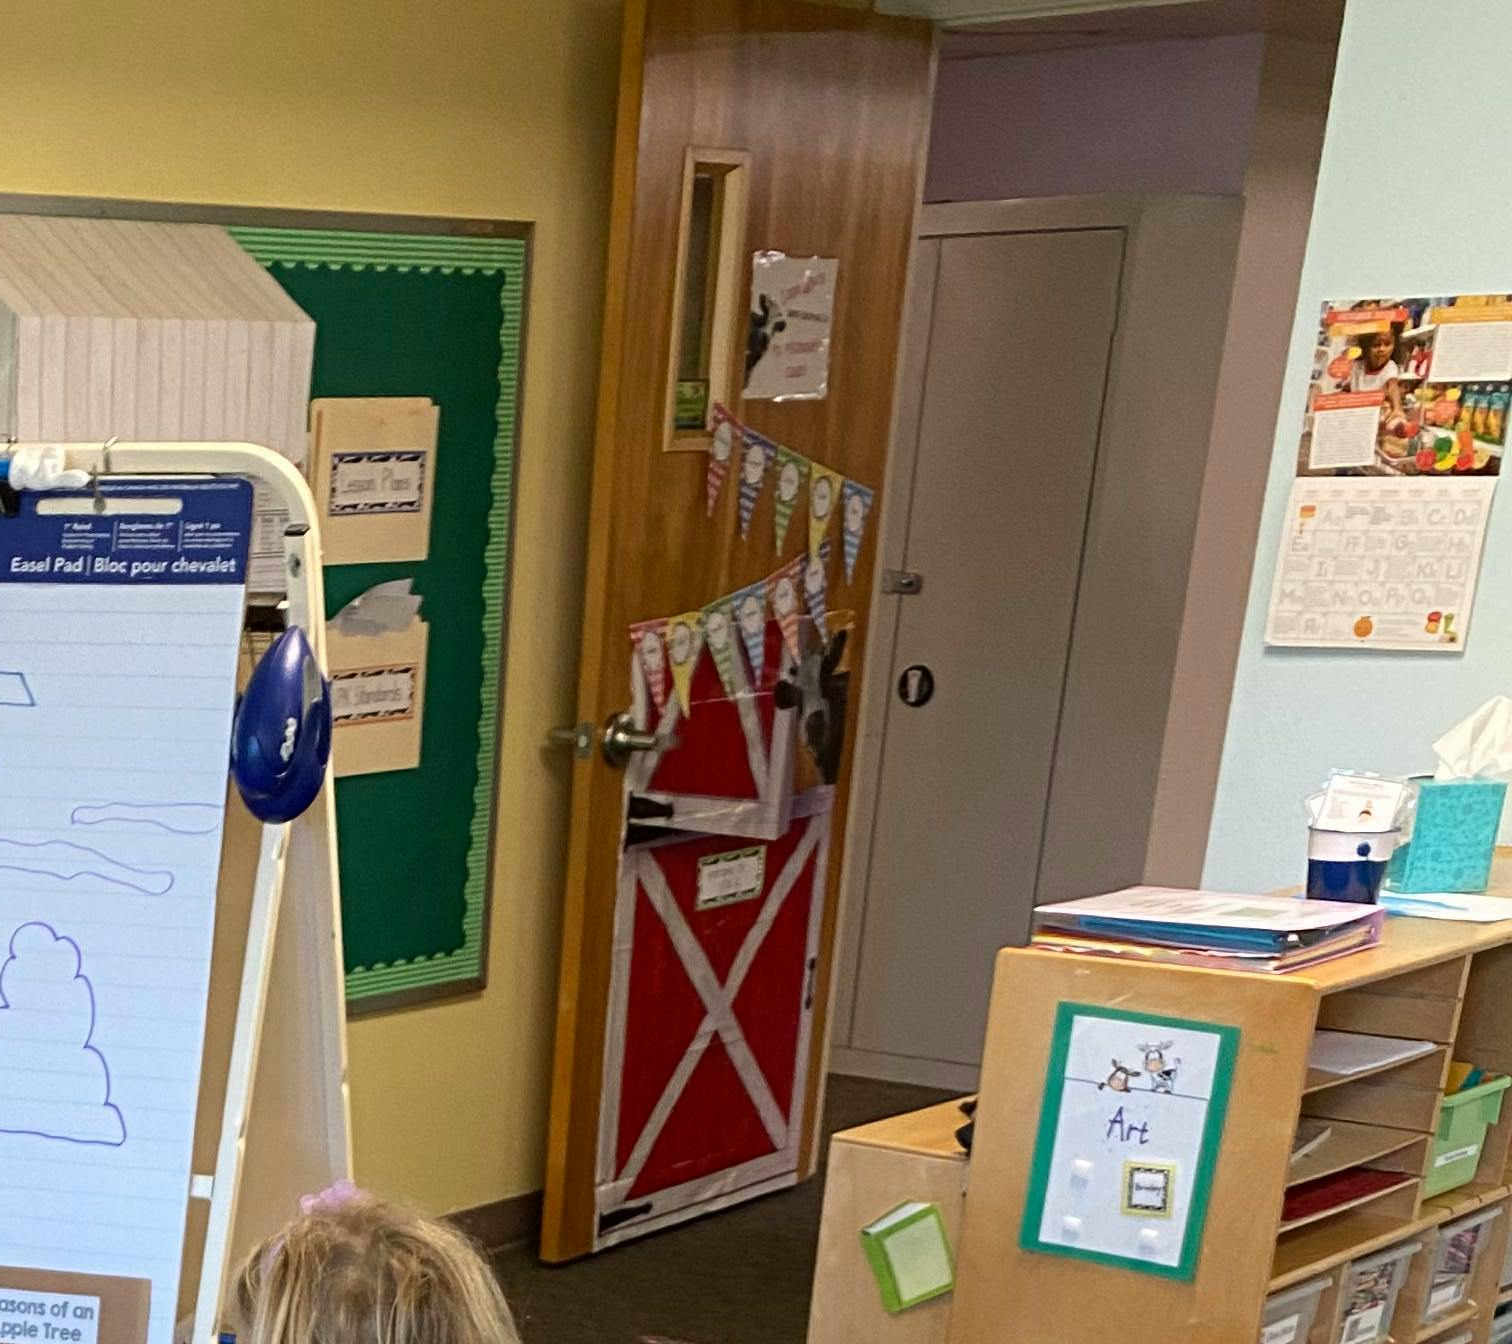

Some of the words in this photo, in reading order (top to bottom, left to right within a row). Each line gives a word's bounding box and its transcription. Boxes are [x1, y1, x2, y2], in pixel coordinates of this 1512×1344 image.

[10, 556, 51, 573] Easel
[53, 556, 83, 573] Pad
[93, 557, 128, 574] Bloc
[130, 560, 169, 577] pour
[171, 555, 237, 574] chevalet
[1106, 1106, 1150, 1145] Art
[50, 1301, 69, 1318] of
[72, 1305, 94, 1321] an
[42, 1322, 82, 1342] Tree
